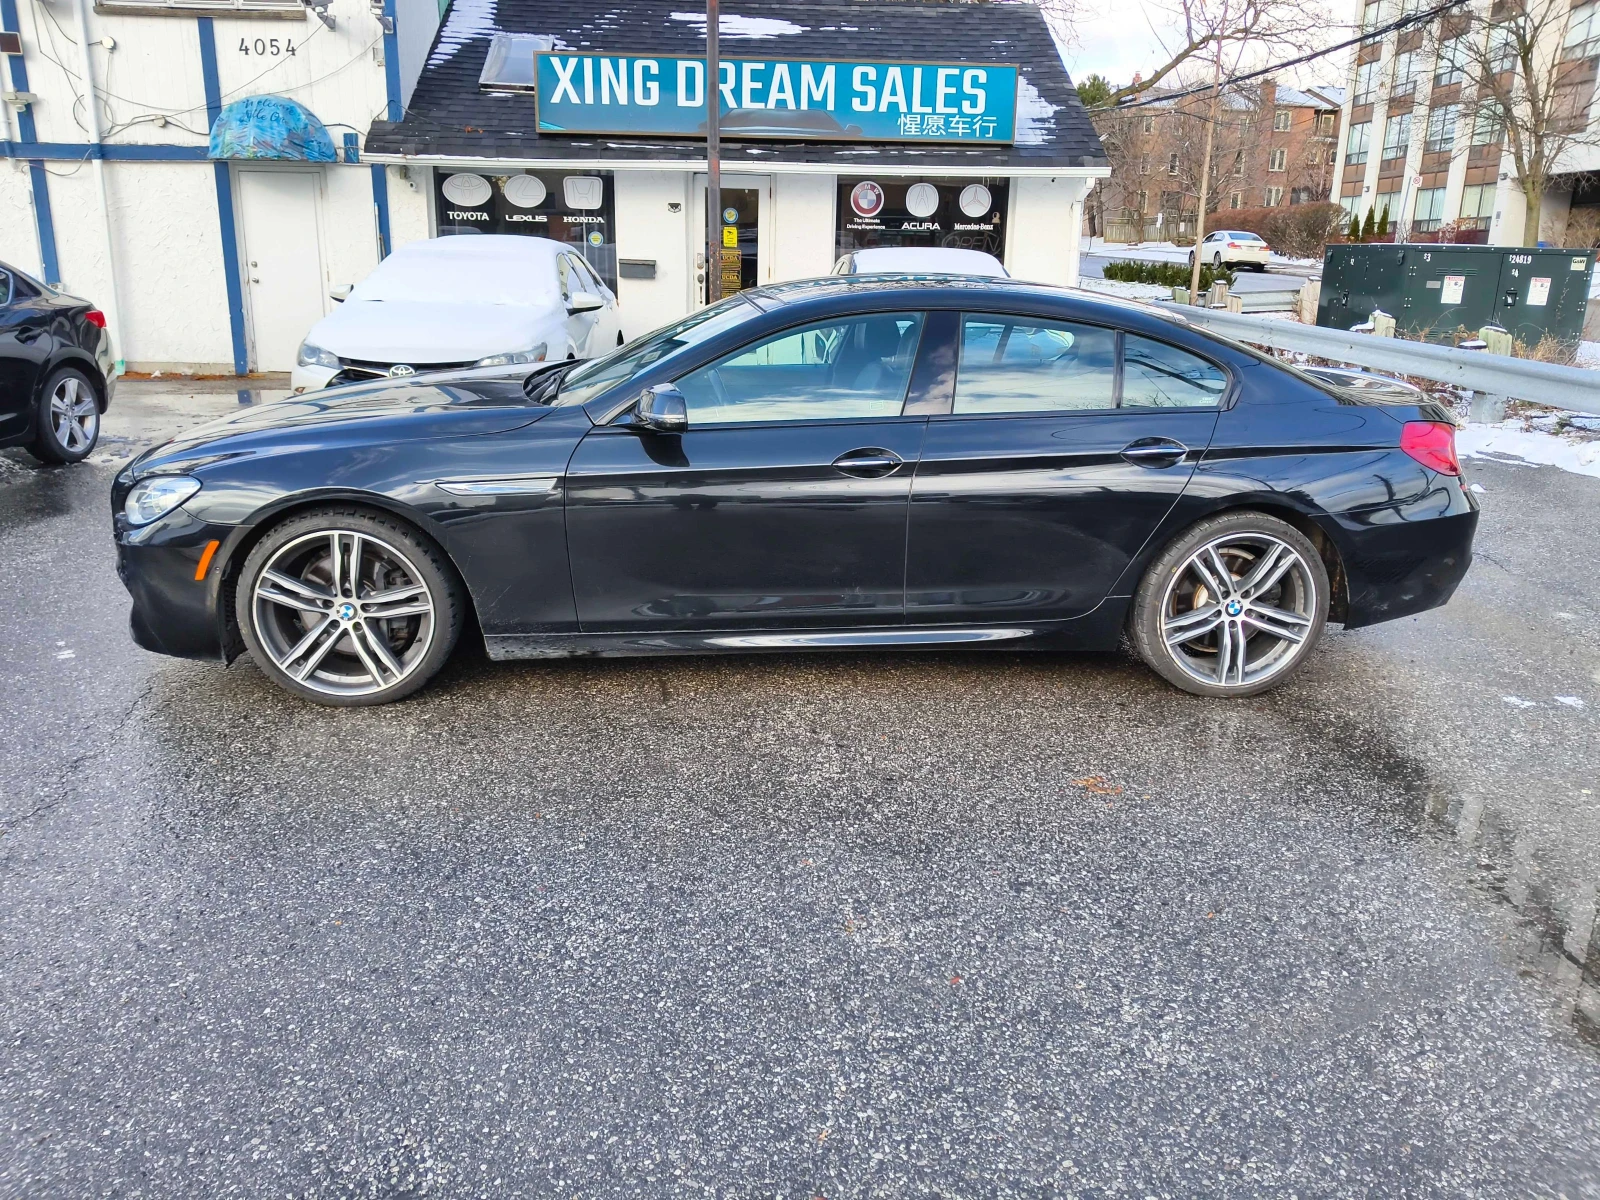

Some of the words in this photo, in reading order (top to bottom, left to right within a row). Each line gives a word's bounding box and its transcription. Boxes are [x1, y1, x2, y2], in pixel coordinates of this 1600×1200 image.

[239, 37, 297, 56] 4054
[549, 56, 660, 106] XING
[677, 60, 836, 111] DREAM
[852, 65, 987, 114] SALES
[897, 113, 998, 137] 惺愿车行
[447, 211, 489, 221] TOYOTA
[505, 214, 547, 222] LEXUS
[901, 222, 941, 230] ACURA
[954, 222, 994, 230] Mercedes-Benz
